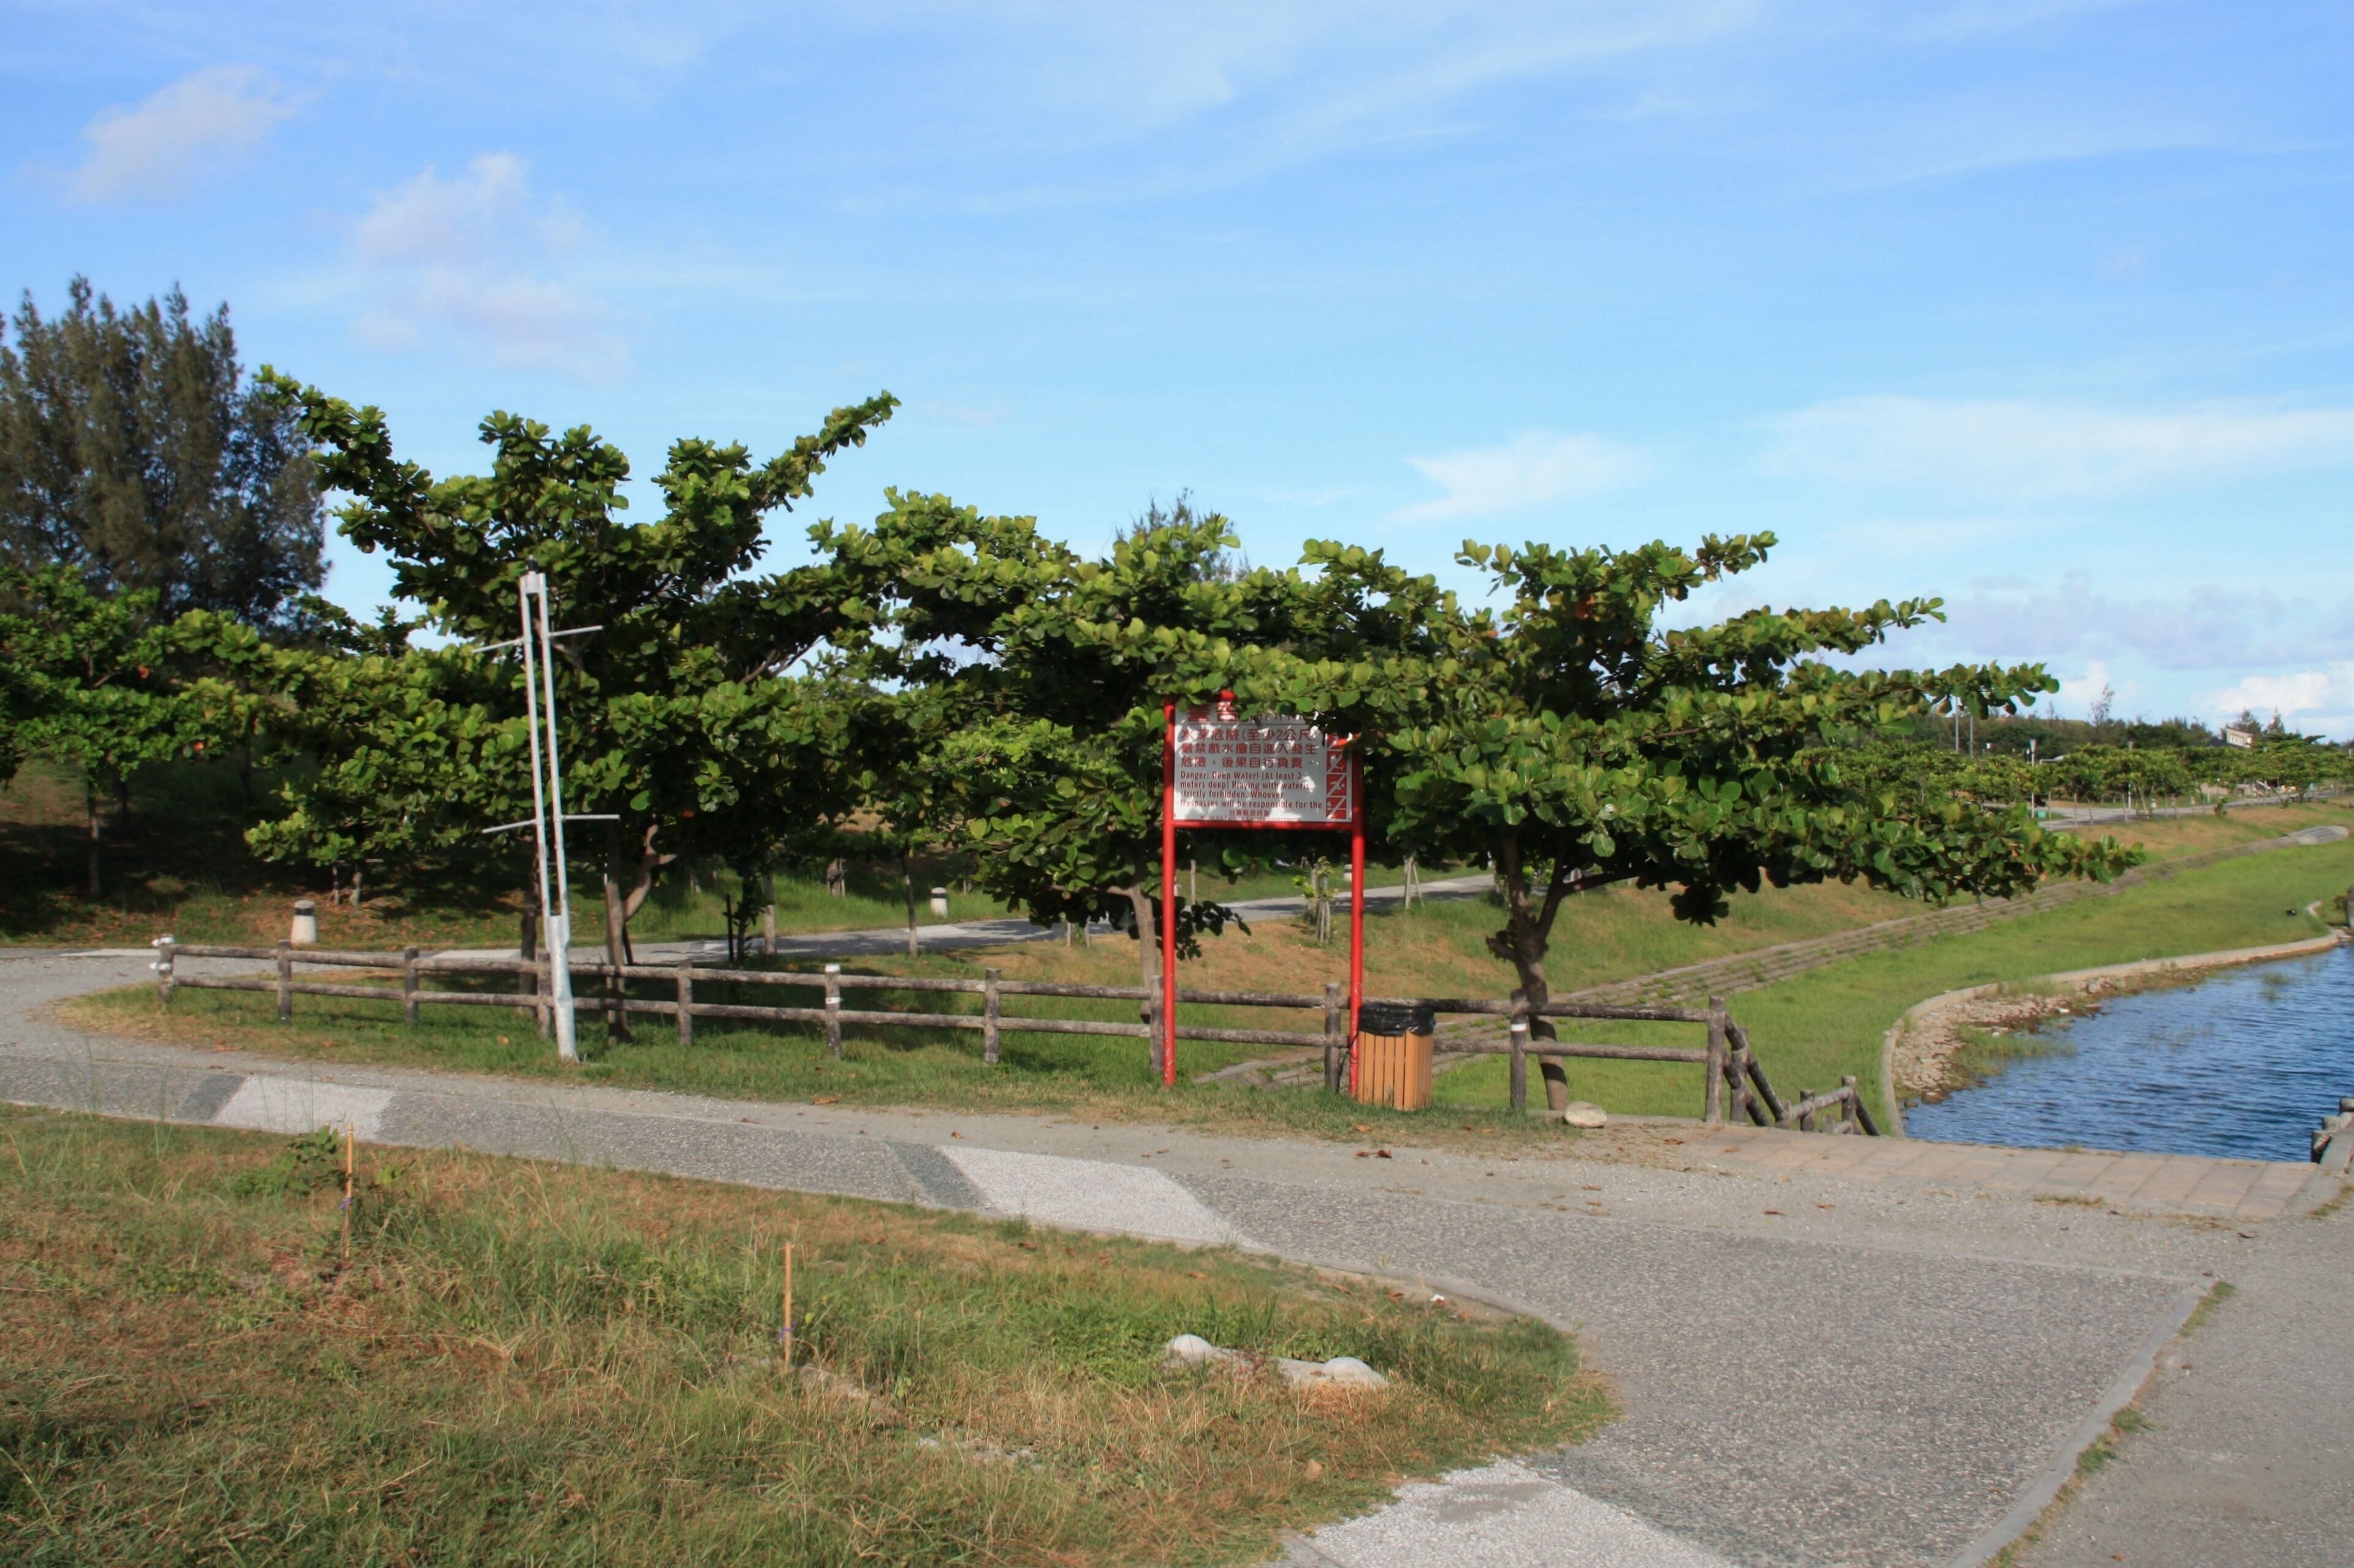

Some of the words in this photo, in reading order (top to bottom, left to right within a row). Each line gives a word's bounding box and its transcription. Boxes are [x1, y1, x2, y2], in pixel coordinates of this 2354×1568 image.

[1181, 771, 1209, 780] Danger:
[1212, 772, 1230, 780] Deep
[1262, 772, 1273, 780] (At
[1208, 781, 1229, 790] deep)
[1232, 782, 1259, 790] Playing
